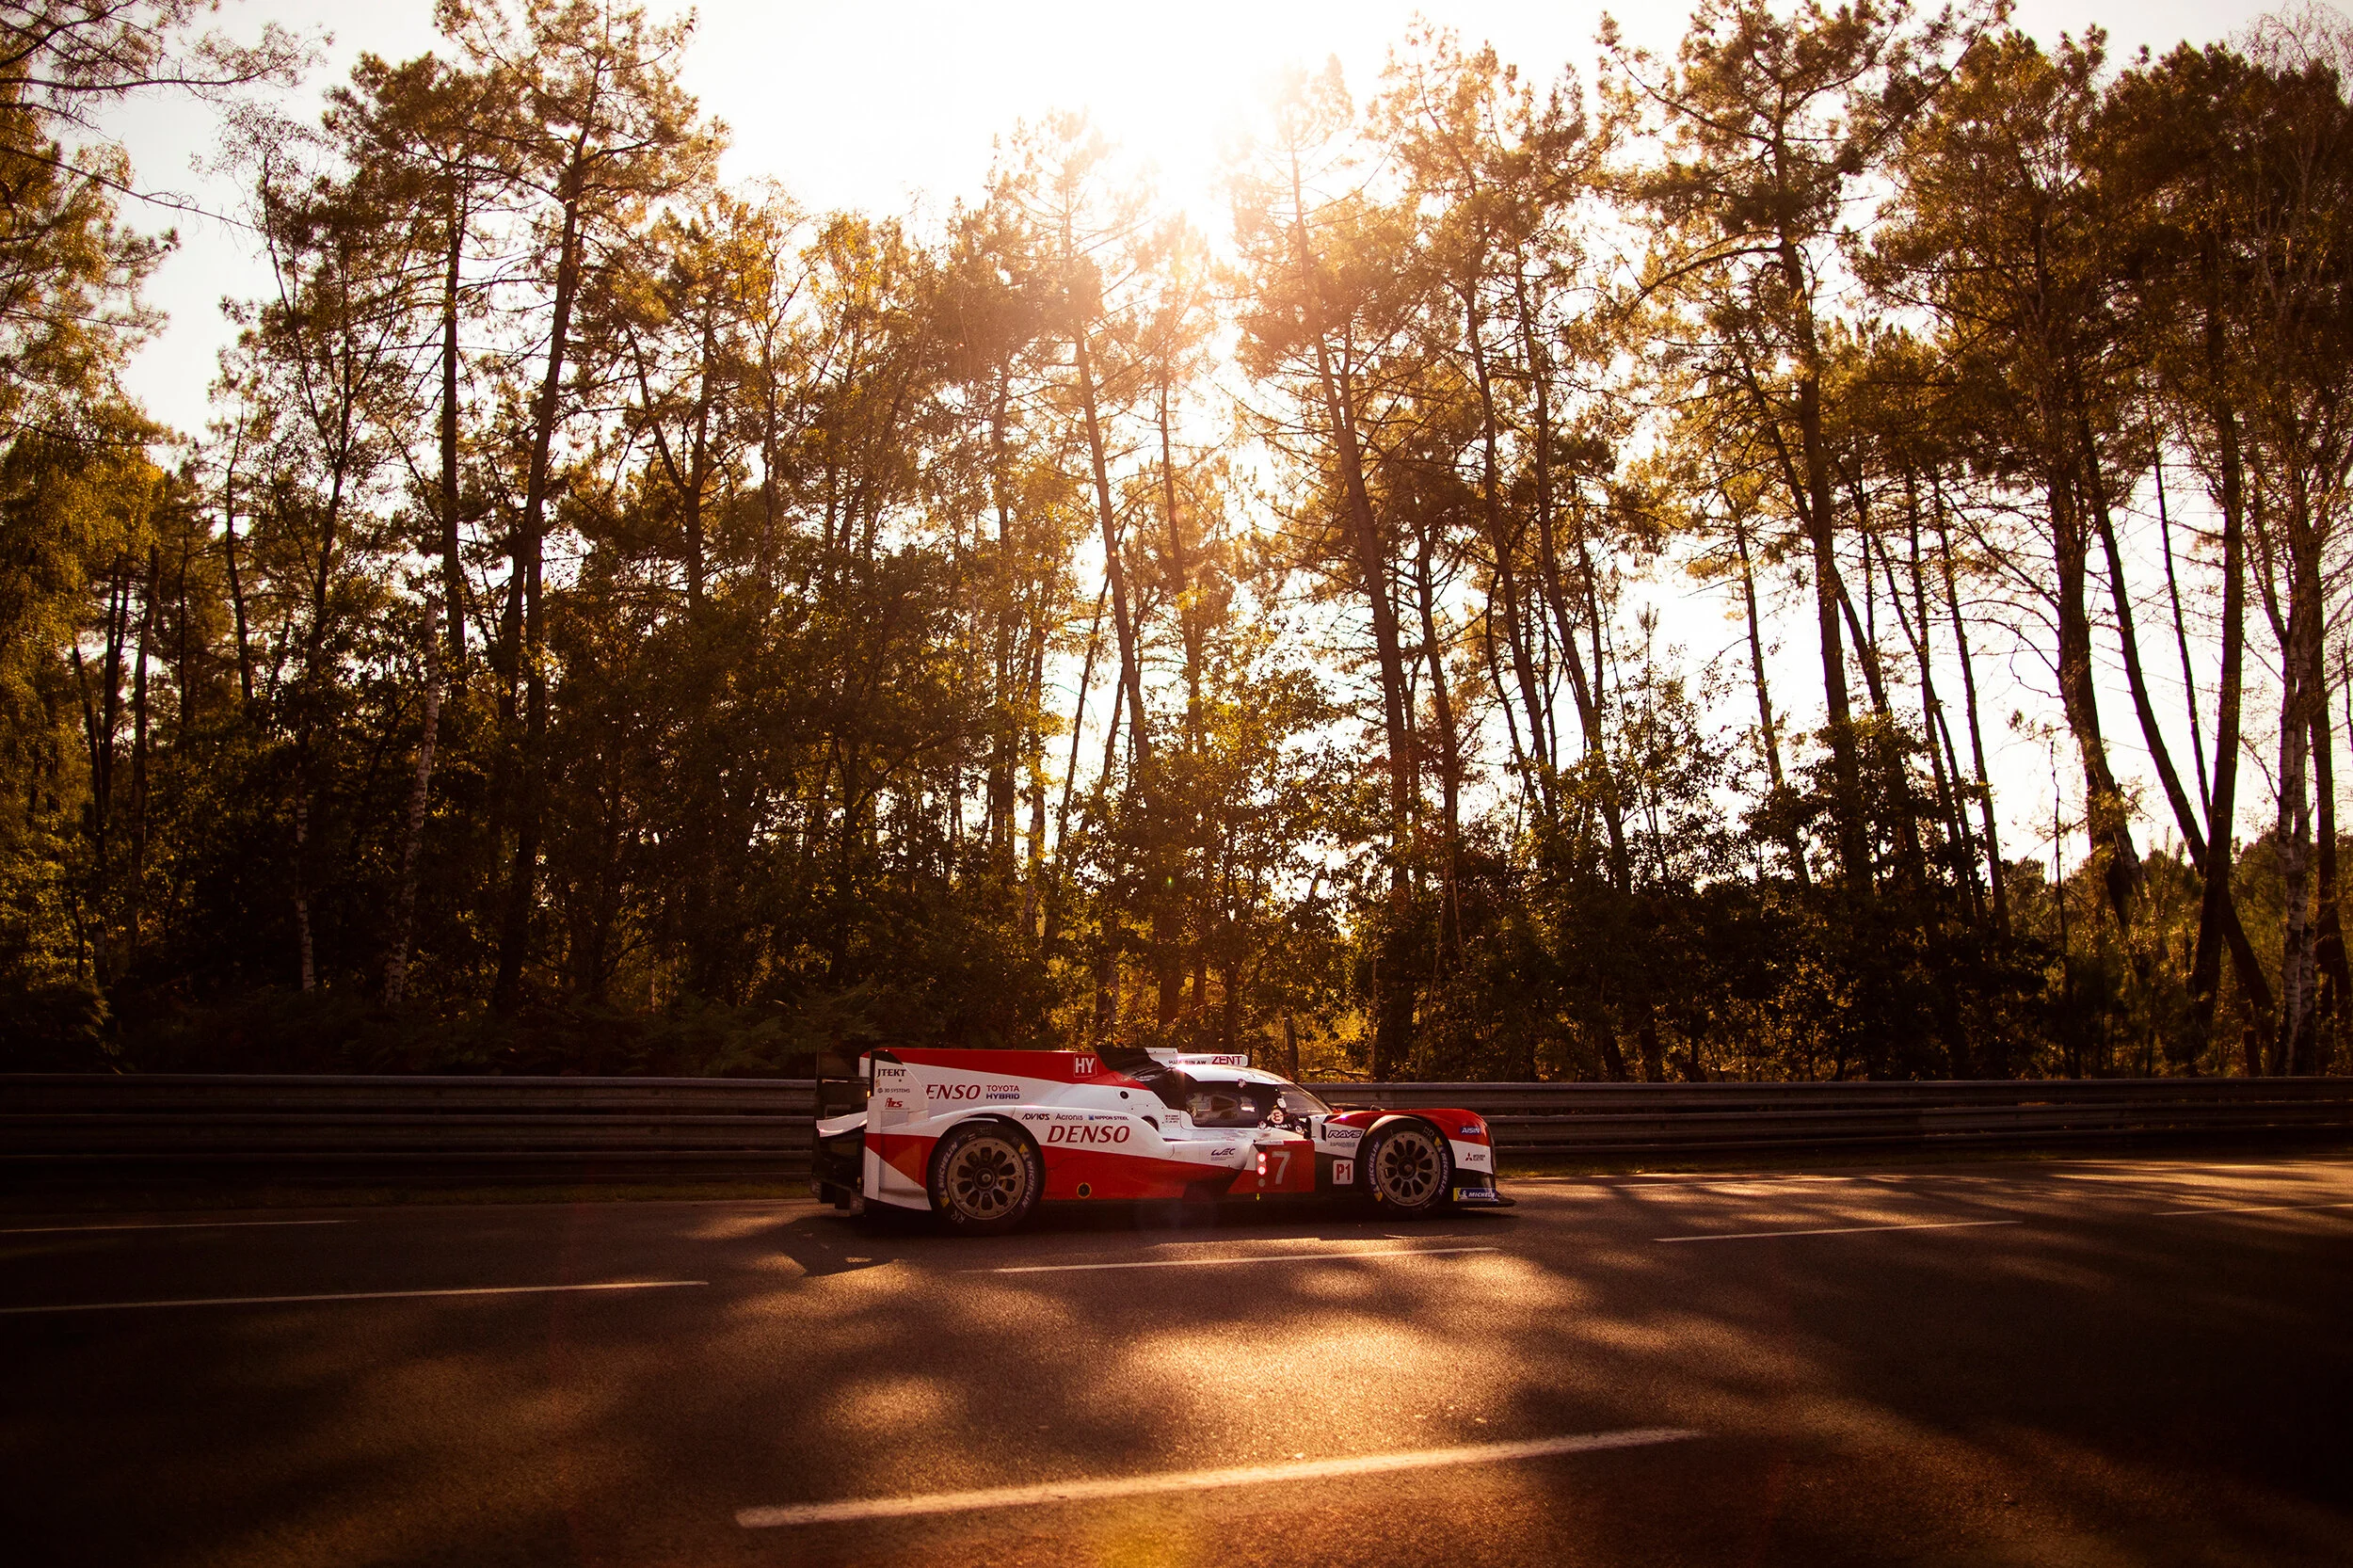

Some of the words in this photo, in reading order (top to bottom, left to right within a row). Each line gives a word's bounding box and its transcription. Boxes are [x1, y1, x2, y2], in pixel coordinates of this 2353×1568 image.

[1075, 1057, 1096, 1074] HY
[1211, 1056, 1242, 1064] ZENT
[877, 1068, 906, 1078] JTEKT
[925, 1084, 982, 1100] ENSO
[1055, 1112, 1083, 1121] Acronis
[1047, 1125, 1130, 1144] DENSO
[1328, 1129, 1362, 1138] RAYS
[938, 1142, 958, 1189] MICHELIN
[1272, 1151, 1291, 1185] 7
[1336, 1162, 1351, 1180] P1
[1021, 1160, 1035, 1208] MICHELIN
